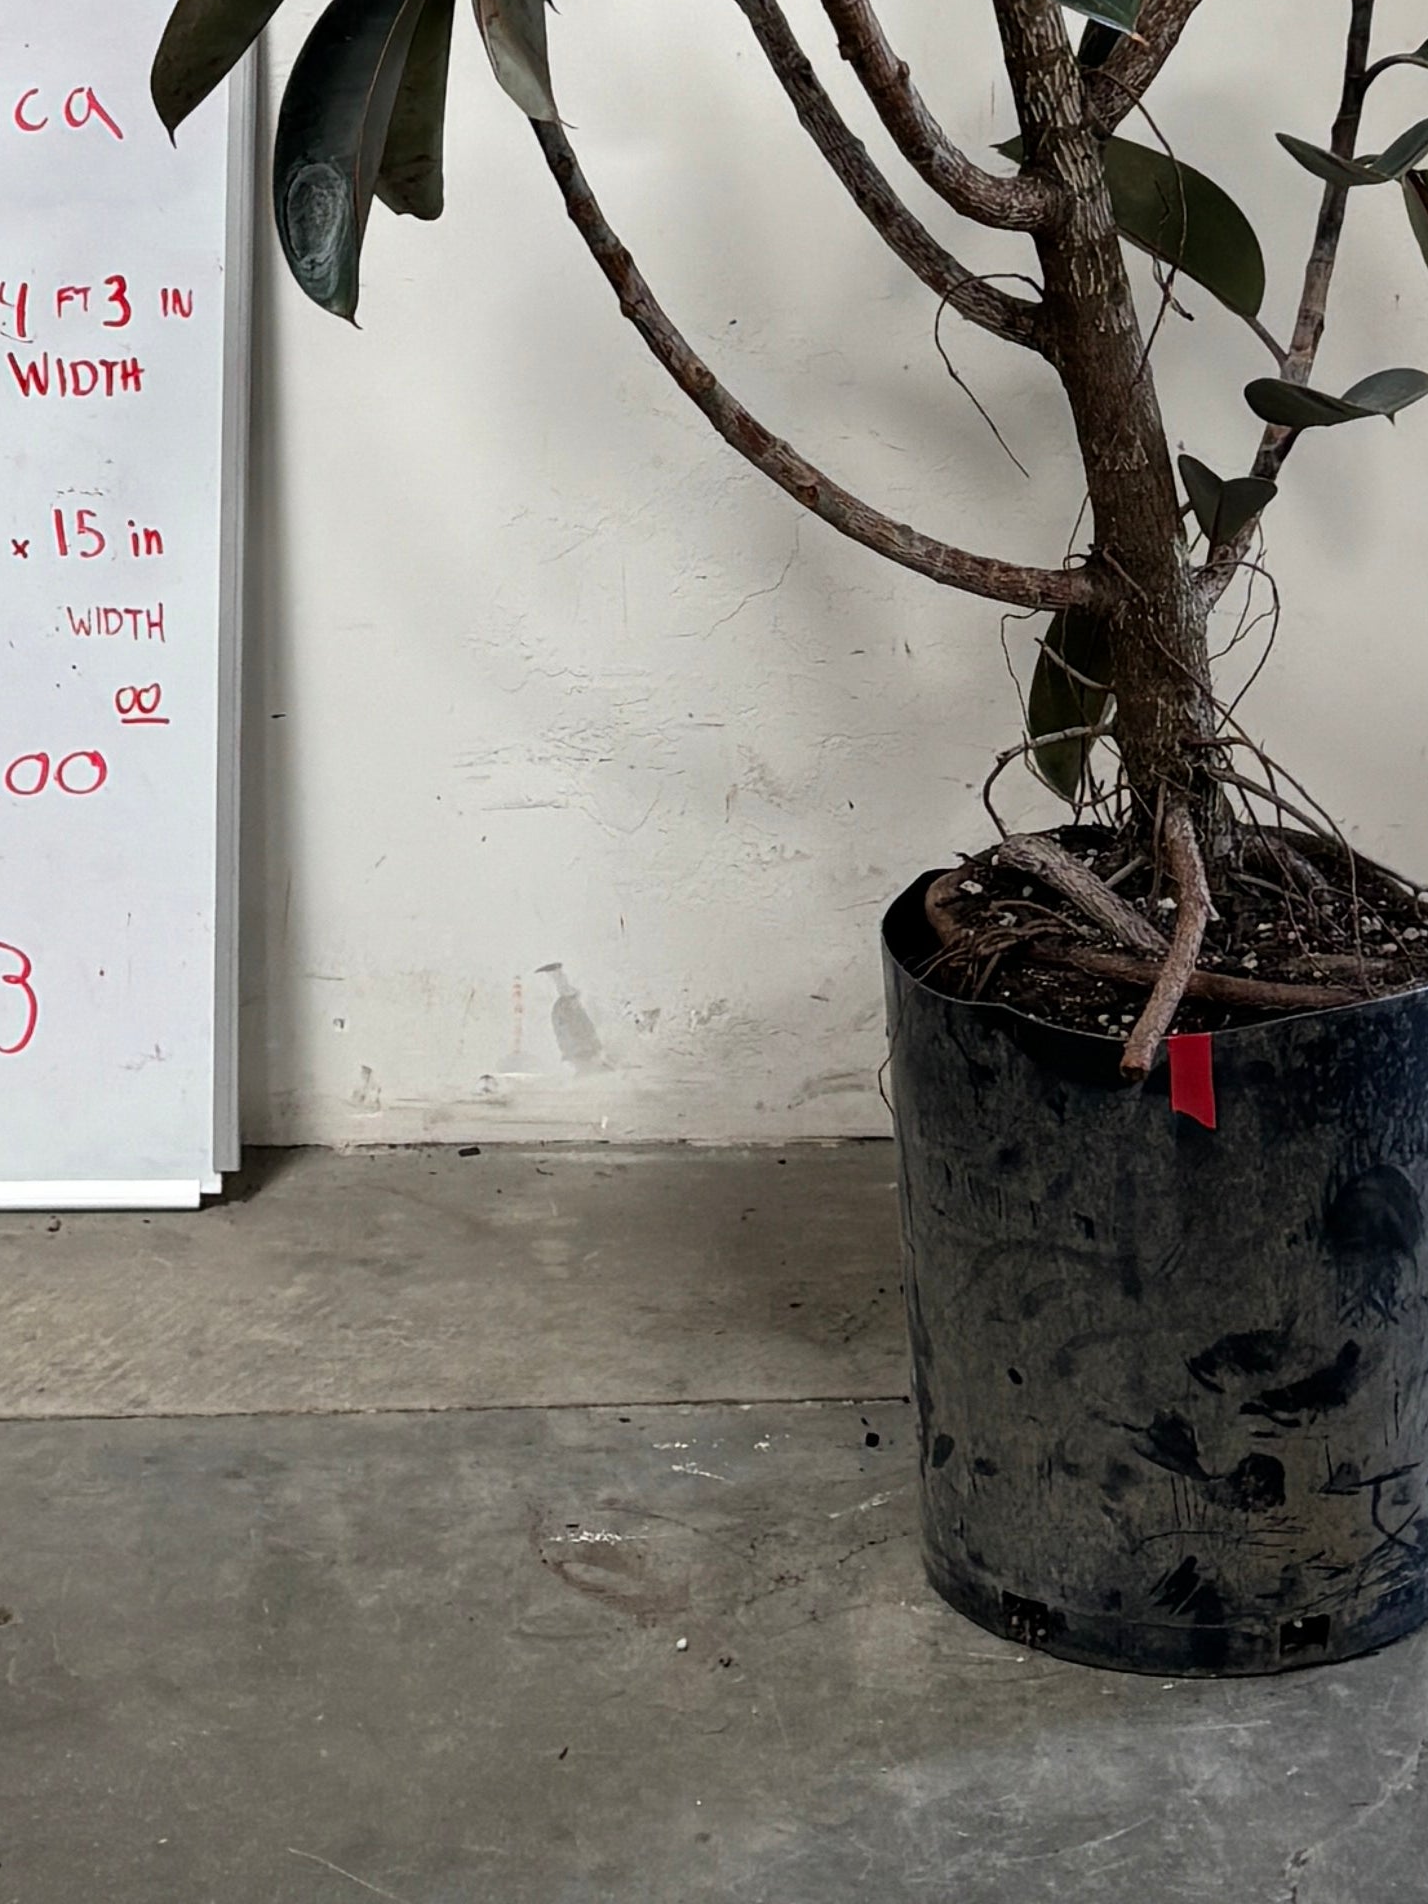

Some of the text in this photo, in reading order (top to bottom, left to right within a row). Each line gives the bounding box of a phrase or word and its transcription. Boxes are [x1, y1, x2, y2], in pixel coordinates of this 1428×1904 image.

[54, 285, 90, 316] FT
[103, 274, 133, 329] 3
[159, 288, 193, 320] IN
[6, 353, 143, 398] WIDTH
[53, 508, 106, 559] 15
[127, 519, 164, 558] in
[66, 602, 166, 643] WIDTH
